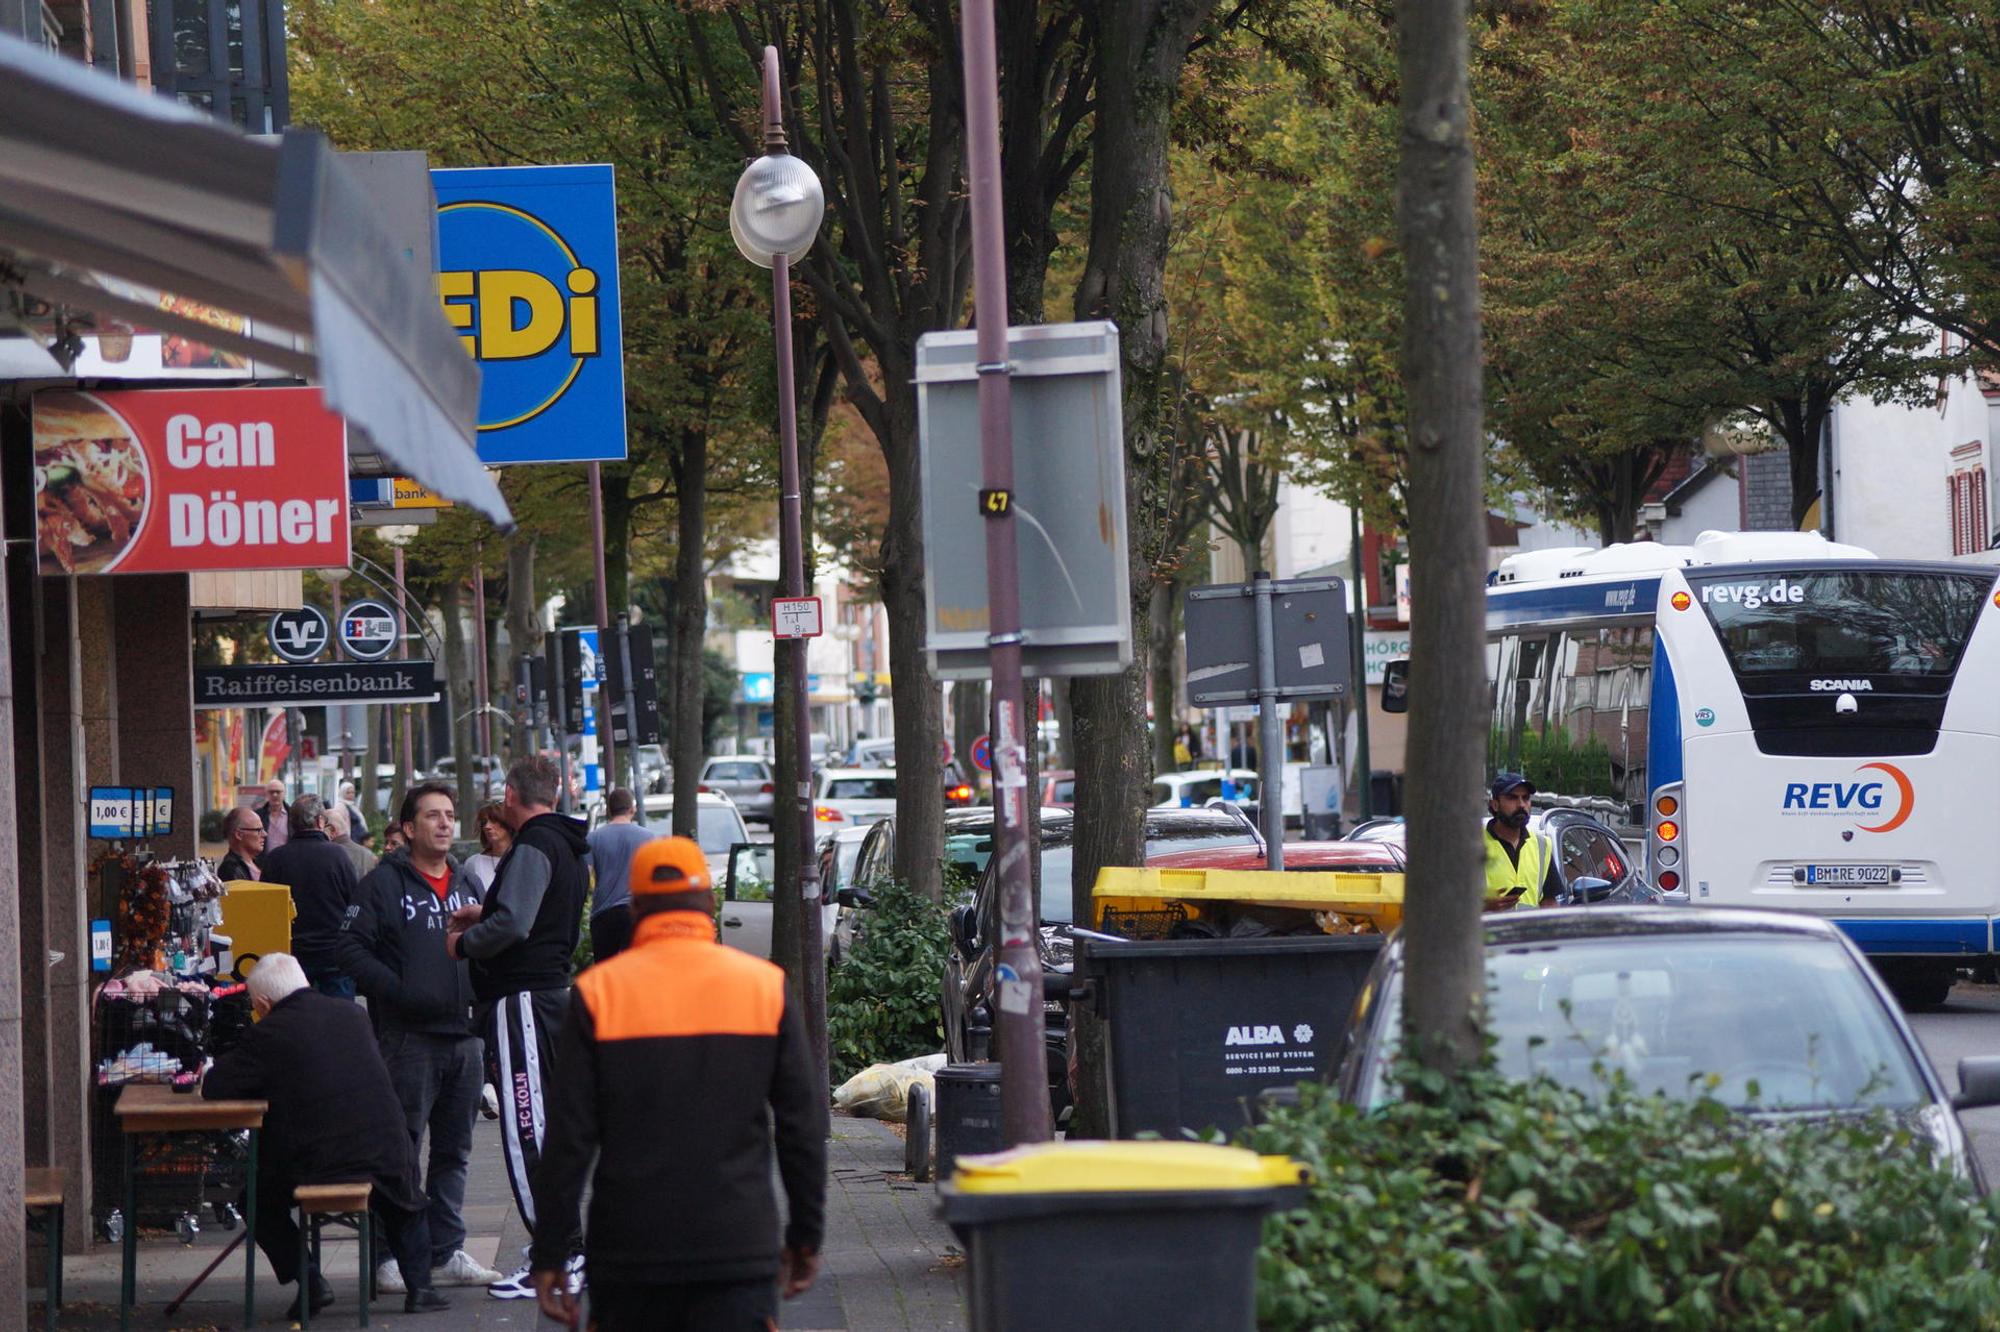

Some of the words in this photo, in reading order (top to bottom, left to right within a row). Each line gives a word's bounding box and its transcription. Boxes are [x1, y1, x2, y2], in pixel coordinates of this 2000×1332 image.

[166, 413, 275, 469] Can
[169, 491, 339, 547] Döner
[1702, 579, 1804, 609] revg.de
[205, 671, 415, 696] Raiffeisenbank
[1810, 679, 1873, 691] SCANIA
[1783, 783, 1883, 809] REVG
[96, 806, 117, 820] 1,00
[120, 806, 127, 818] €
[1817, 868, 1831, 880] BM
[1840, 868, 1854, 880] RE
[1858, 868, 1886, 880] 9022
[1225, 1025, 1286, 1046] ALBA
[1225, 1052, 1258, 1060] SERVICE
[515, 1072, 530, 1109] KÖLN
[519, 1109, 532, 1127] FC
